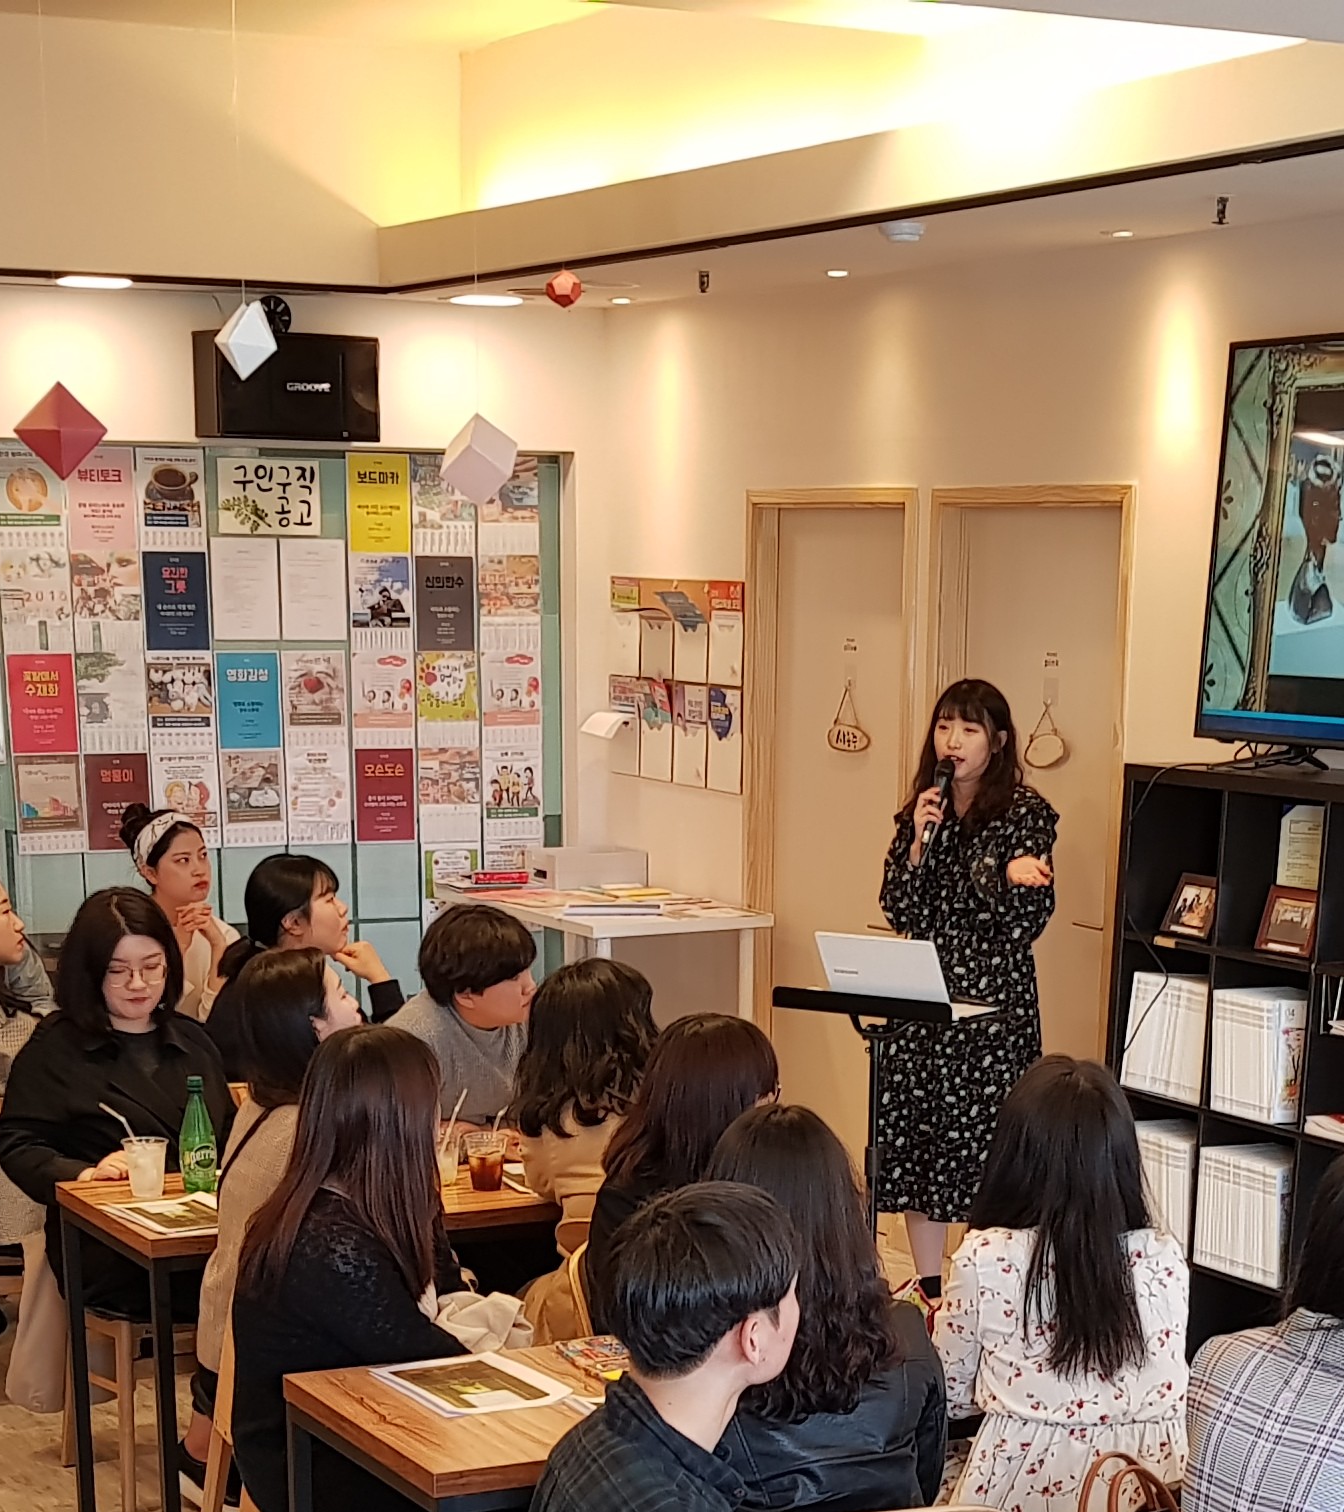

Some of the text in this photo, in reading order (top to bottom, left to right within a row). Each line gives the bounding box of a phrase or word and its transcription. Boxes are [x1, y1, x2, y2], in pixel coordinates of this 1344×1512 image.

[286, 382, 332, 393] GROOVE
[77, 469, 122, 483] 뷰티토크
[233, 465, 315, 495] 구인구직
[357, 471, 400, 485] 보드마카
[275, 496, 312, 527] 공고
[364, 762, 405, 777] 오손도손
